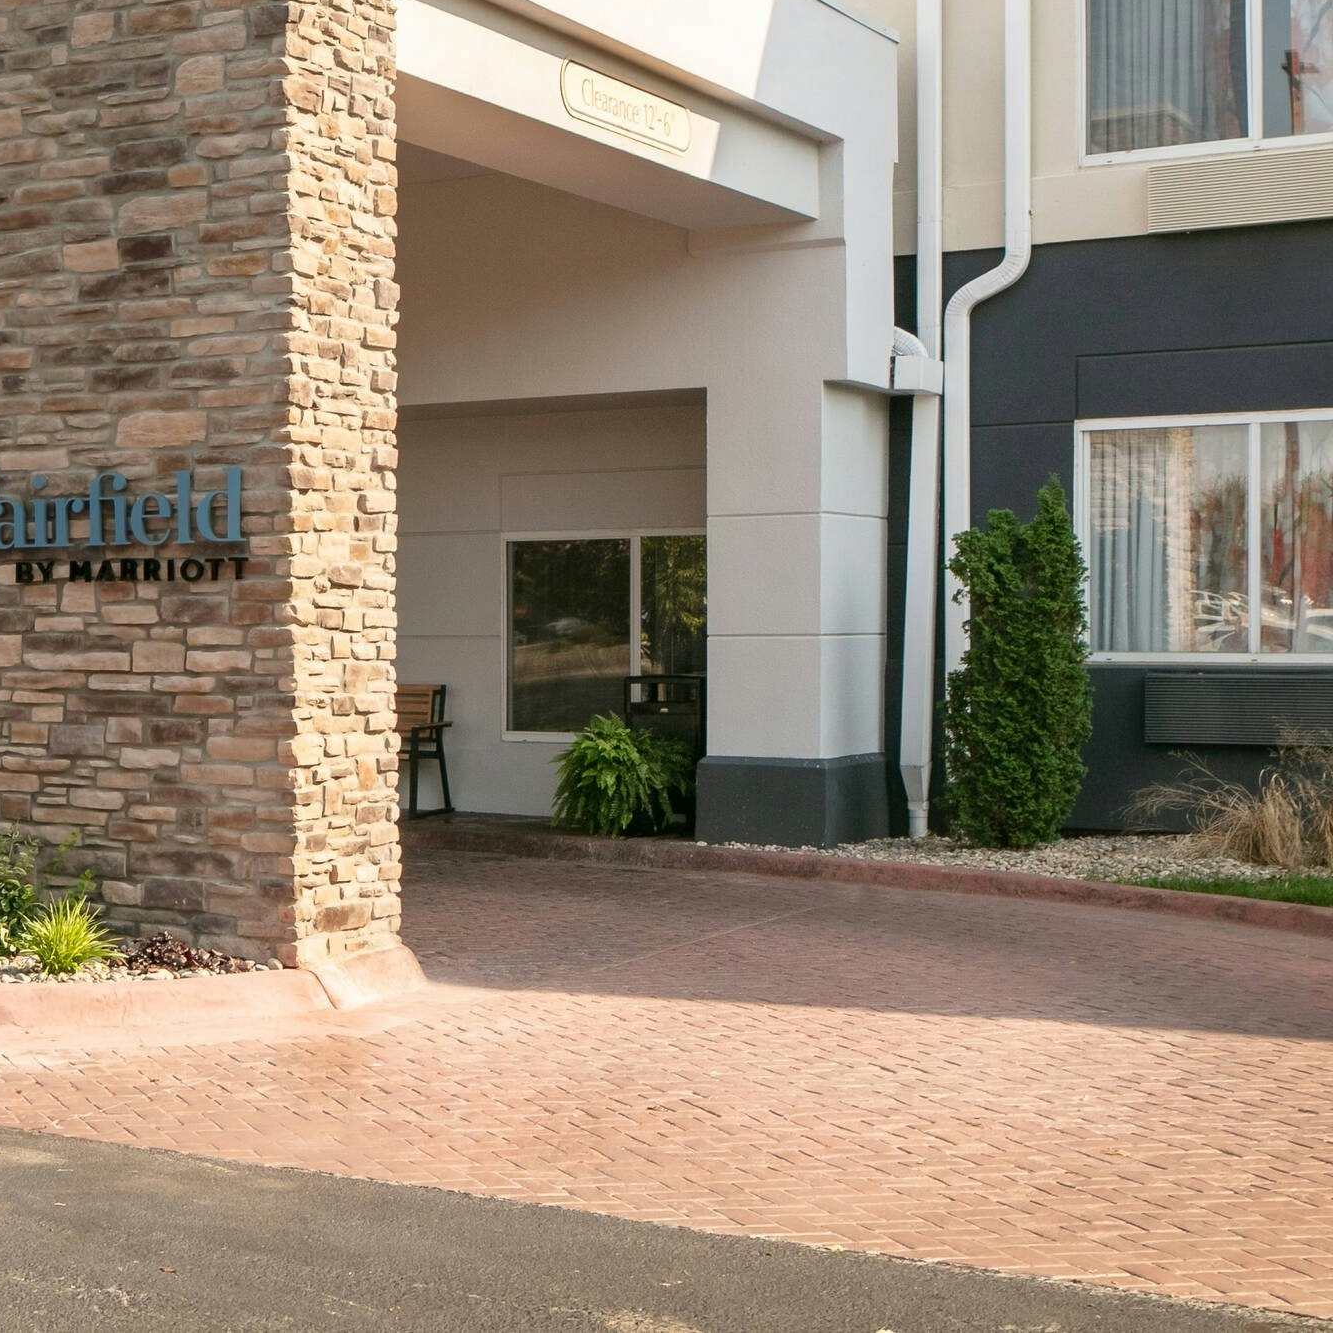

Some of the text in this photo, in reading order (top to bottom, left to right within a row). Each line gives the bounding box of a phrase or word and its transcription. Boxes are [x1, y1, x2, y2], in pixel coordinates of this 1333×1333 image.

[581, 78, 640, 125] Clearance
[15, 557, 249, 584] BY MARRIOTT
